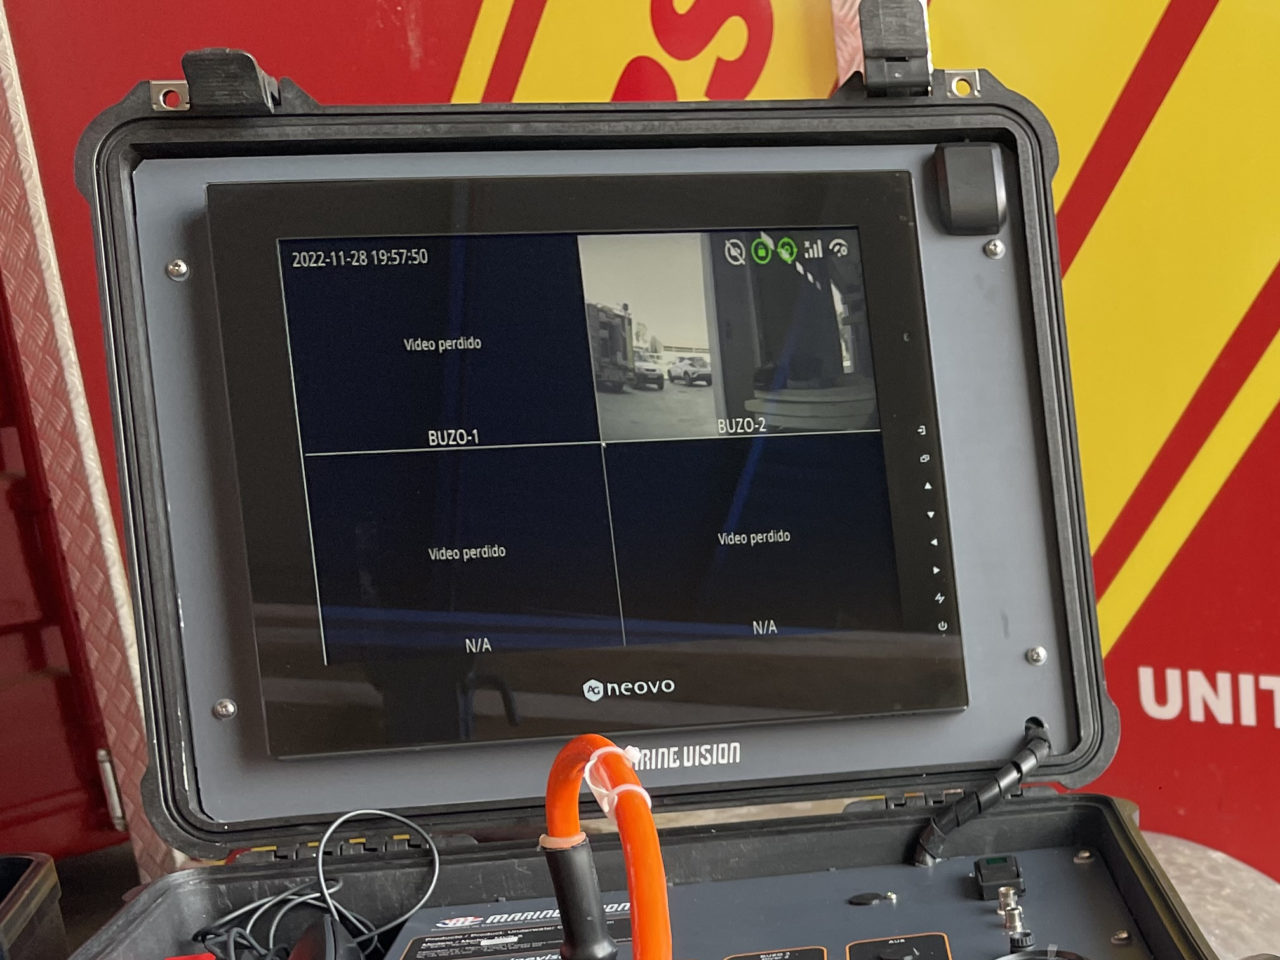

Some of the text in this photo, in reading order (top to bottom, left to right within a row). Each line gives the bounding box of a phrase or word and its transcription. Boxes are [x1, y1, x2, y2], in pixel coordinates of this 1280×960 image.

[292, 248, 429, 268] 2022-11-28 19:57:50
[403, 336, 482, 353] Video perdido
[717, 416, 767, 434] BUZO-2
[428, 428, 480, 446] BUZO-1
[717, 529, 791, 547] Video perdido
[428, 544, 506, 562] Video perdido
[752, 619, 778, 636] N/A
[465, 637, 493, 654] N/A
[606, 679, 675, 697] neovo
[682, 742, 741, 768] VISION
